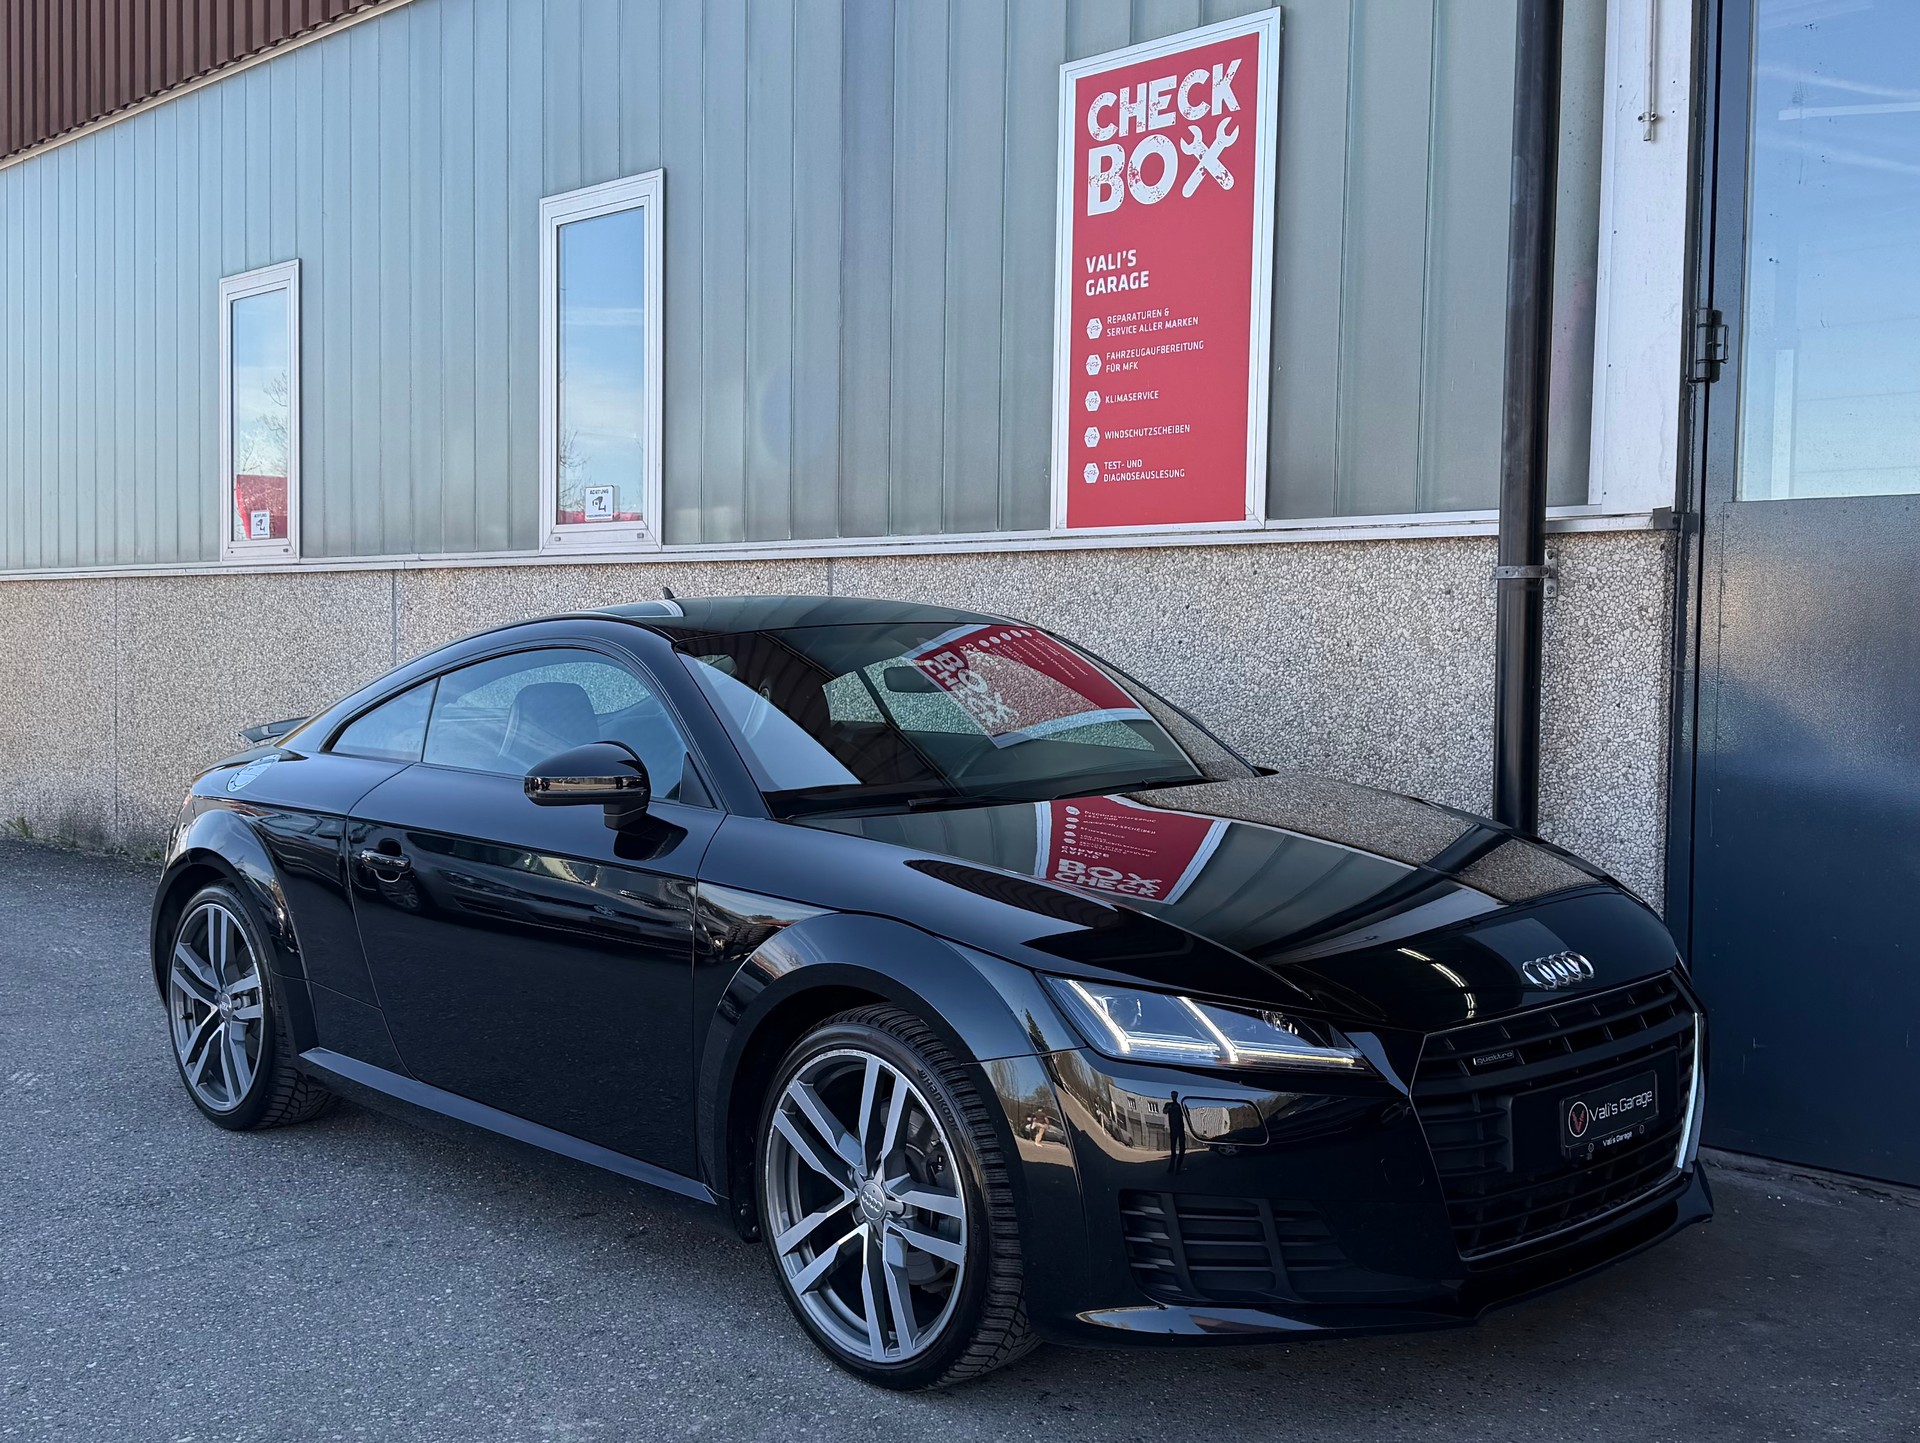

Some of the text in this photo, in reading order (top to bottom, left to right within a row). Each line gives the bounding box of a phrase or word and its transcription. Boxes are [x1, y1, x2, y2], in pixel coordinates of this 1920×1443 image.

[1087, 58, 1242, 141] CHECK
[1087, 116, 1240, 216] BOX
[1085, 249, 1137, 273] VALI'S
[1085, 270, 1149, 296] GARAGE
[1106, 307, 1170, 324] REPARATUREN &
[1106, 316, 1199, 337] SERVICE ALLER MARKEN
[1106, 340, 1204, 360] FAHRZEUGAUFBEREITUNG
[1105, 361, 1139, 373] FÜR MFK
[1105, 390, 1159, 404] KLIMASERVICE
[1104, 424, 1191, 440] WINDSCHUTZSCHEIBEN
[1103, 459, 1142, 470] TEST- UND
[1103, 469, 1185, 482] DIAGNOSEAUSLESUNG
[1476, 1051, 1514, 1065] quattro
[1589, 1090, 1653, 1121] Vali's Garage
[1616, 1131, 1633, 1142] Garage
